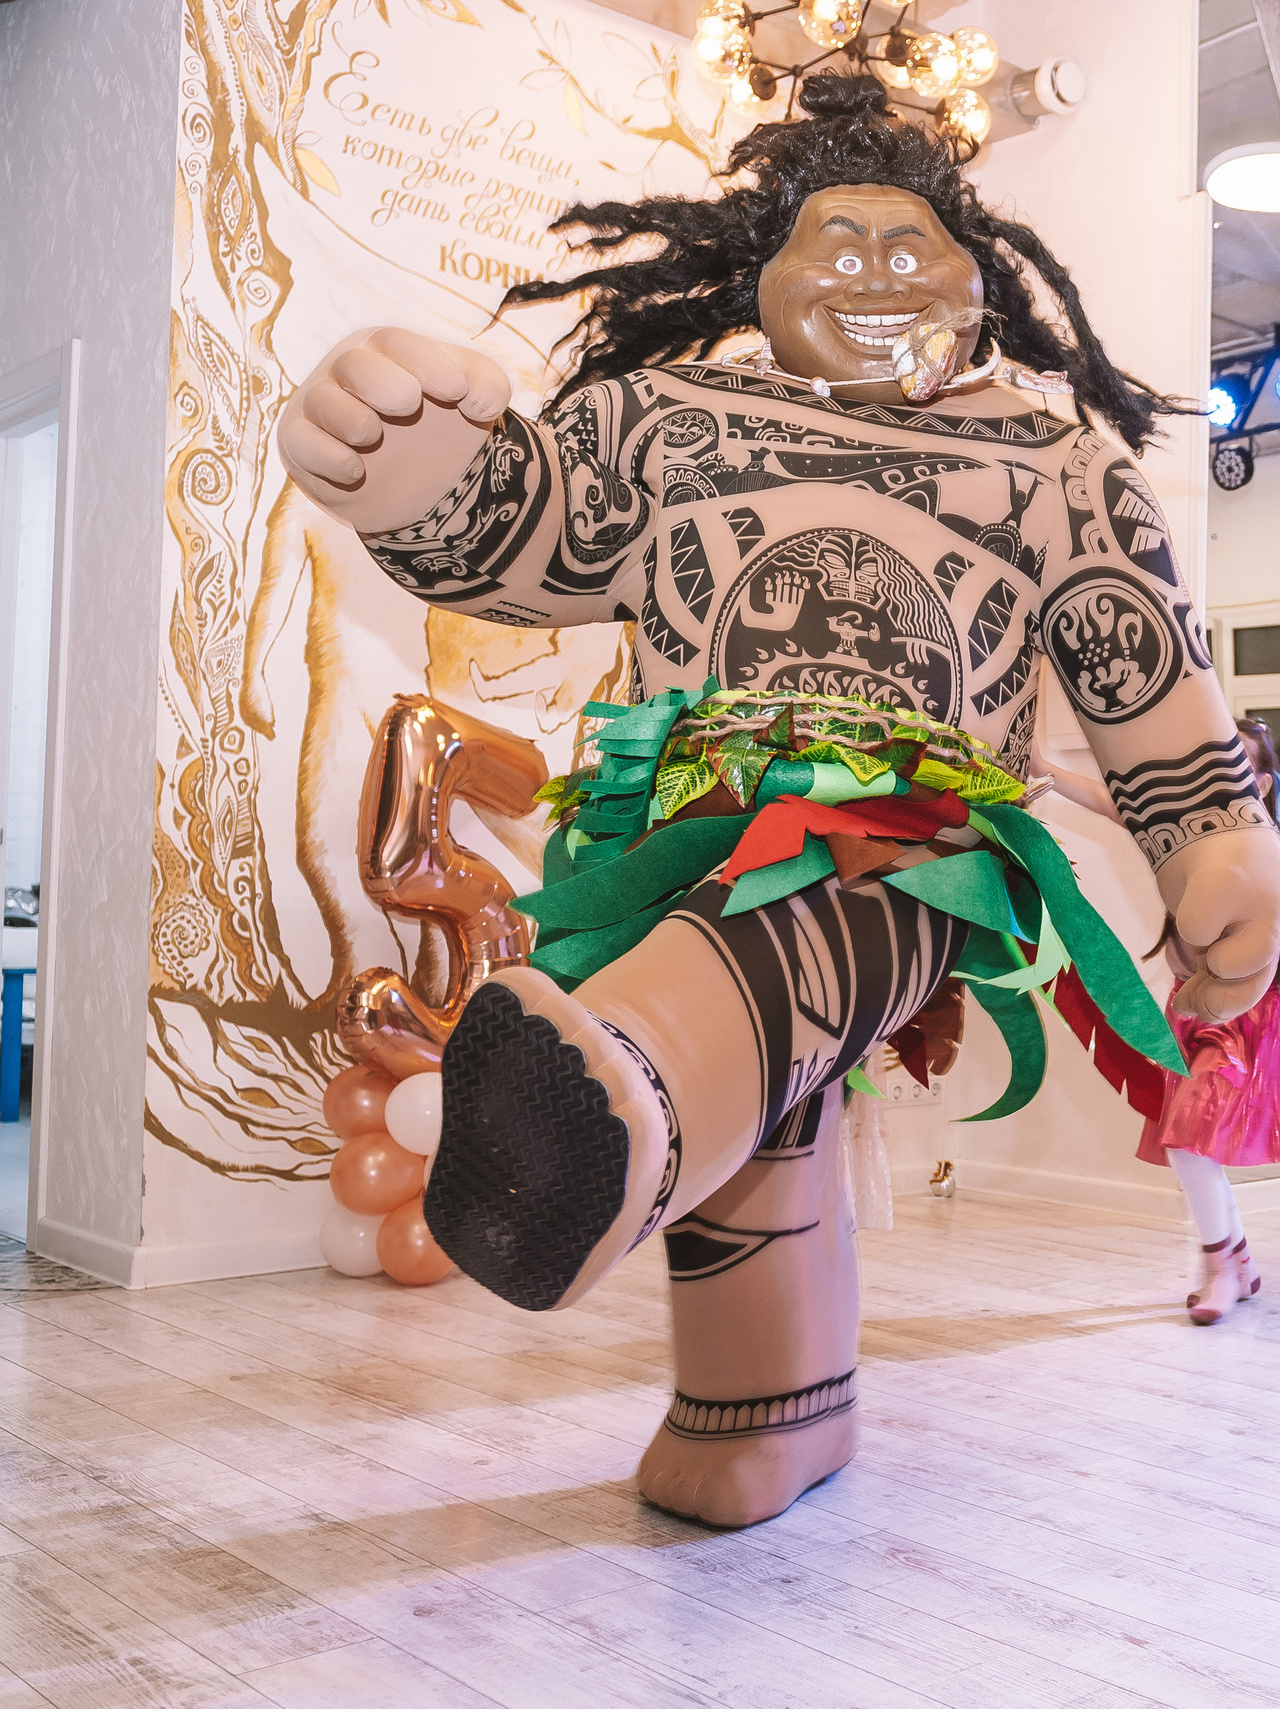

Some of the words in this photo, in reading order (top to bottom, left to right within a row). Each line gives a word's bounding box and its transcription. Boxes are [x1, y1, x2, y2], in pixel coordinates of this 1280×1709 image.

[323, 19, 432, 136] Есть
[430, 105, 499, 159] две
[499, 118, 580, 189] вещи,
[341, 133, 475, 190] которые
[464, 177, 569, 222] родит
[370, 188, 450, 227] дать
[459, 202, 546, 250] своим
